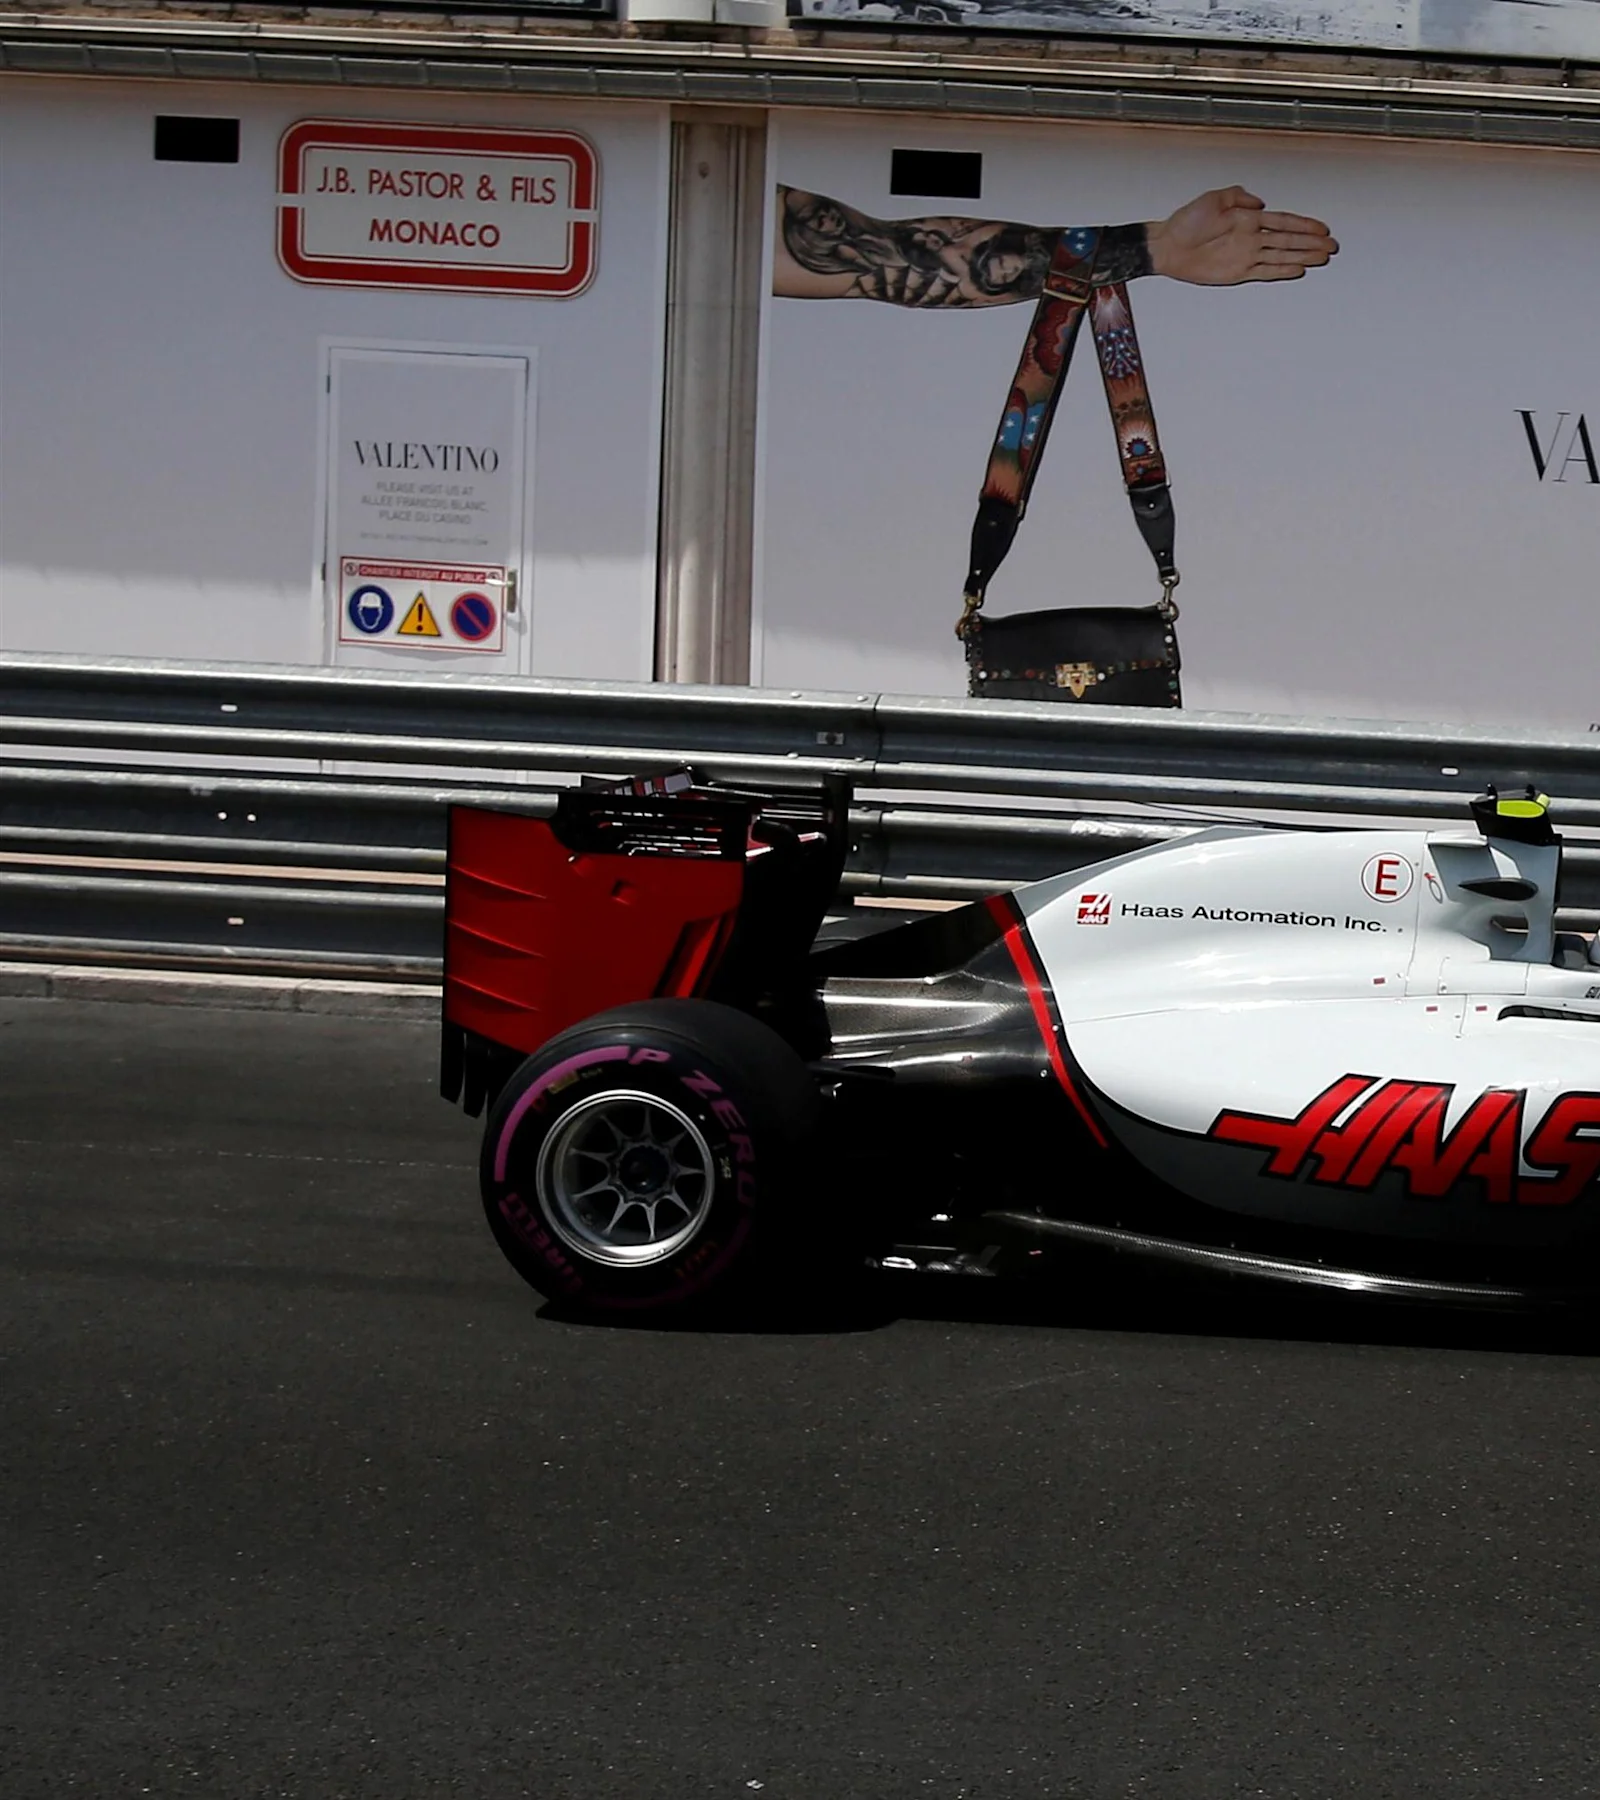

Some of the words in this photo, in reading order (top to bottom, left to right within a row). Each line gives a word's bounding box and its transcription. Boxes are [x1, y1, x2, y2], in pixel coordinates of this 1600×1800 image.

[316, 167, 355, 193] J.B.
[368, 169, 464, 199] PASTOR
[476, 174, 497, 201] &
[511, 176, 556, 204] FILS
[369, 218, 500, 248] MONACO
[353, 440, 499, 474] VALENTINO
[376, 481, 416, 493] PLEASE
[379, 510, 412, 522] PLACE
[415, 511, 430, 523] DU
[1375, 860, 1399, 896] E
[1121, 903, 1184, 919] Haas
[1191, 906, 1336, 928] Automation
[1344, 916, 1387, 933] Inc.
[628, 1047, 672, 1066] P
